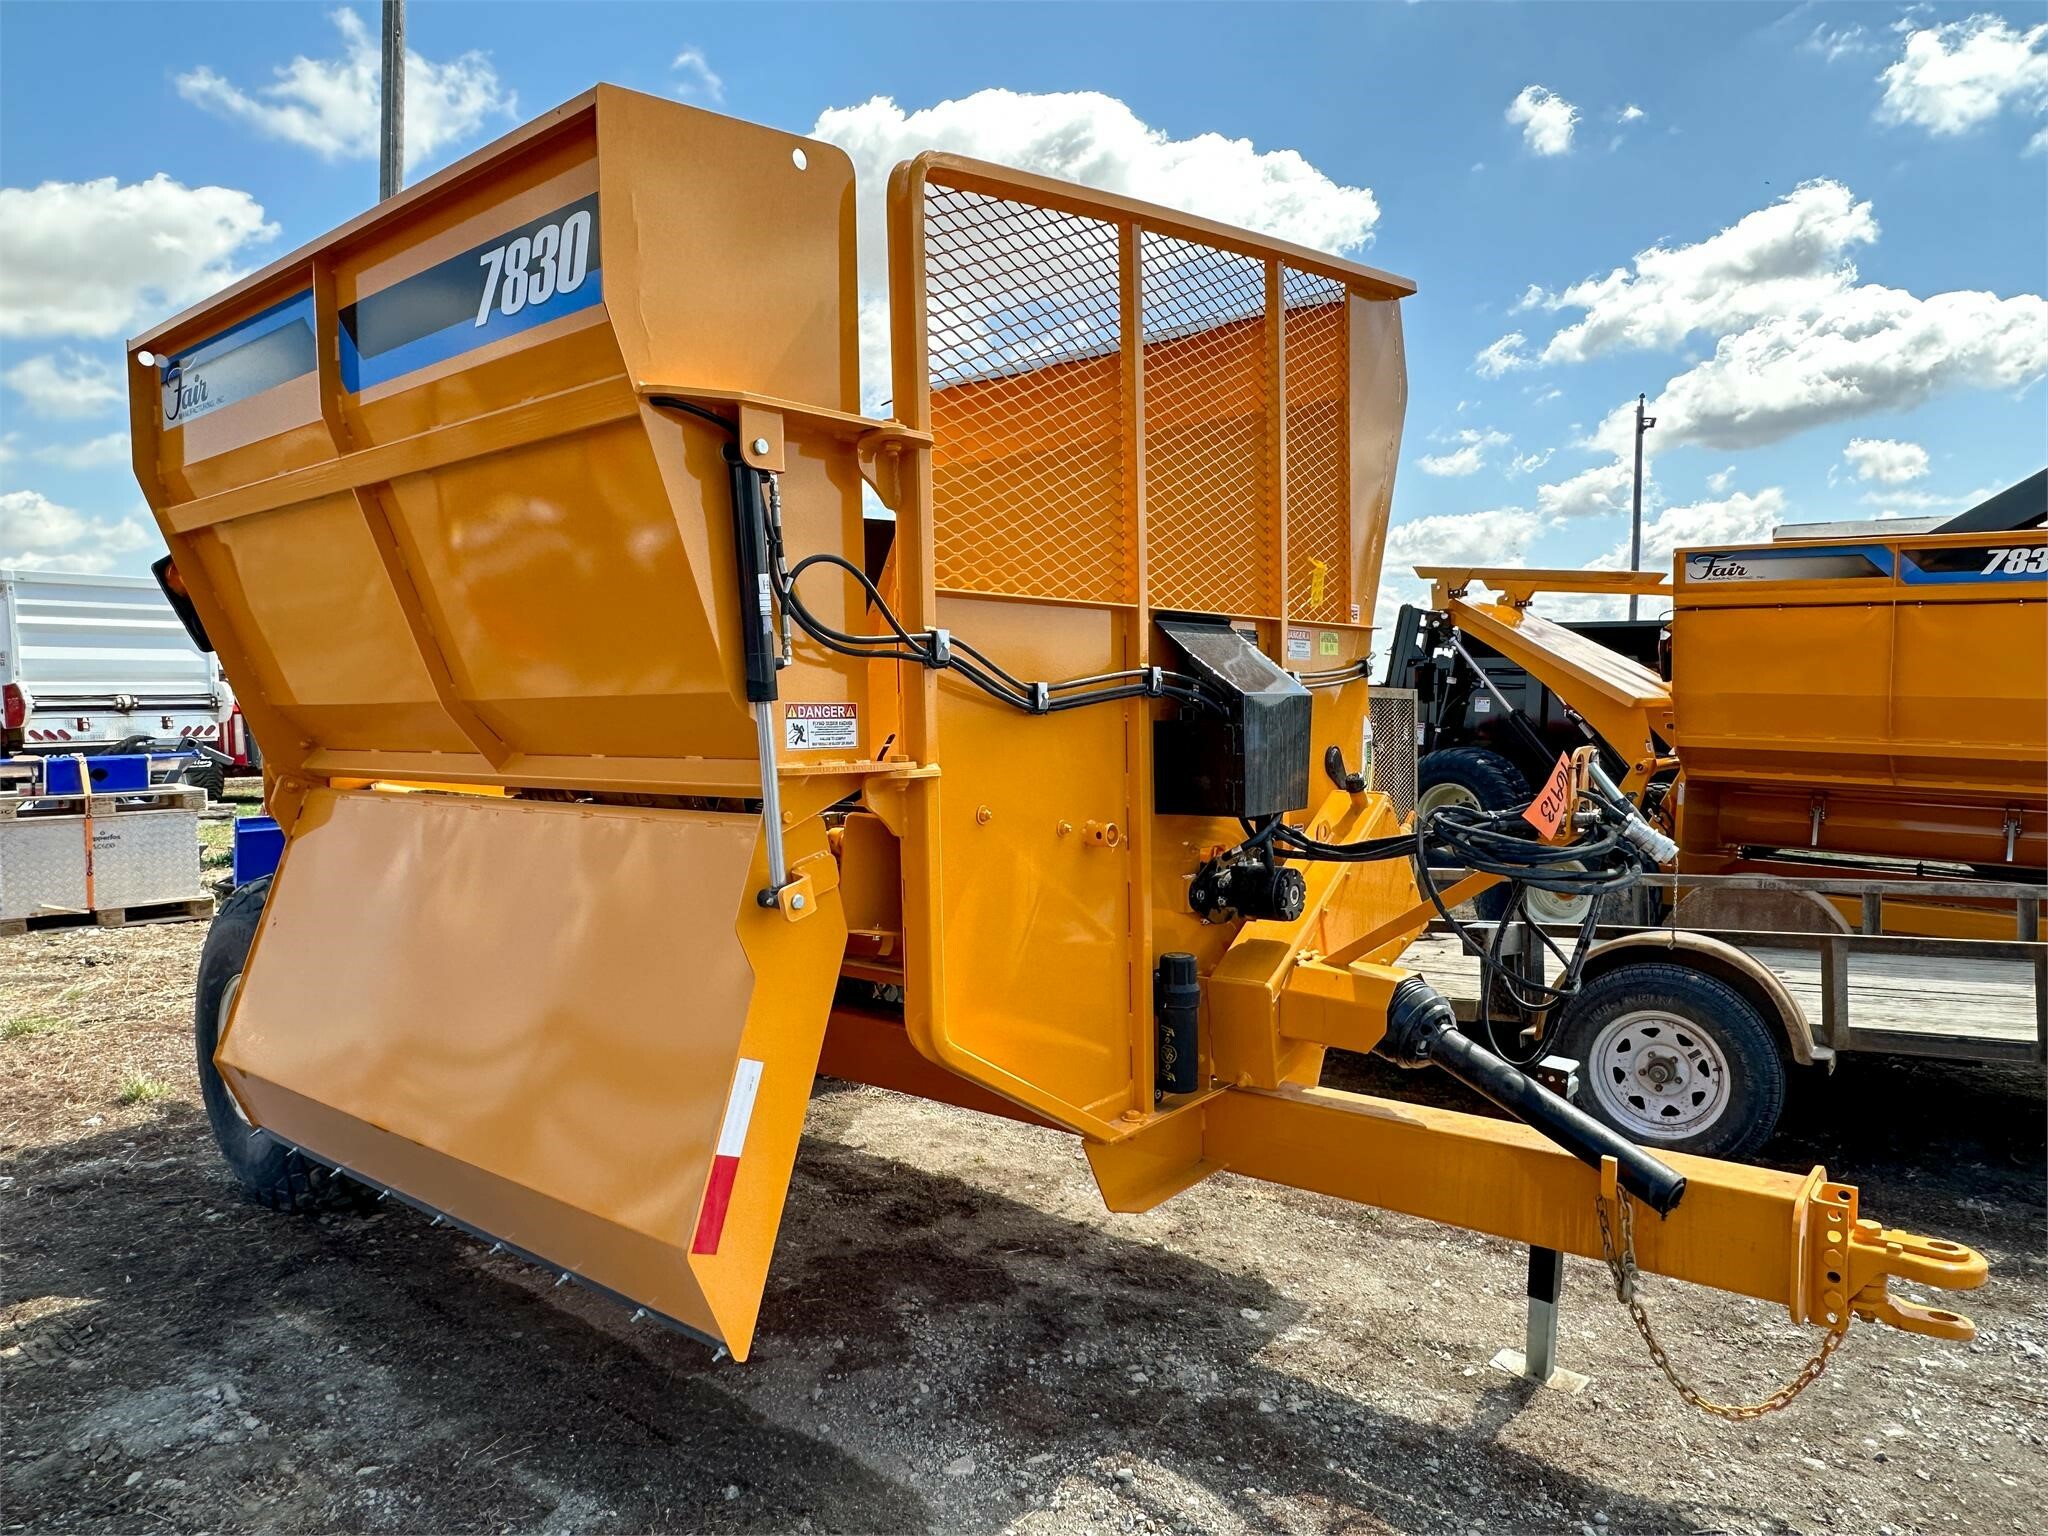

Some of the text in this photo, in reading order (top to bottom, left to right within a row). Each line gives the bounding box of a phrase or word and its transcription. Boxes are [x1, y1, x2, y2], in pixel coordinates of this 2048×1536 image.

[475, 210, 591, 328] 7830
[165, 354, 209, 421] Fair
[1689, 554, 1749, 579] Fair
[797, 705, 846, 718] DANGER
